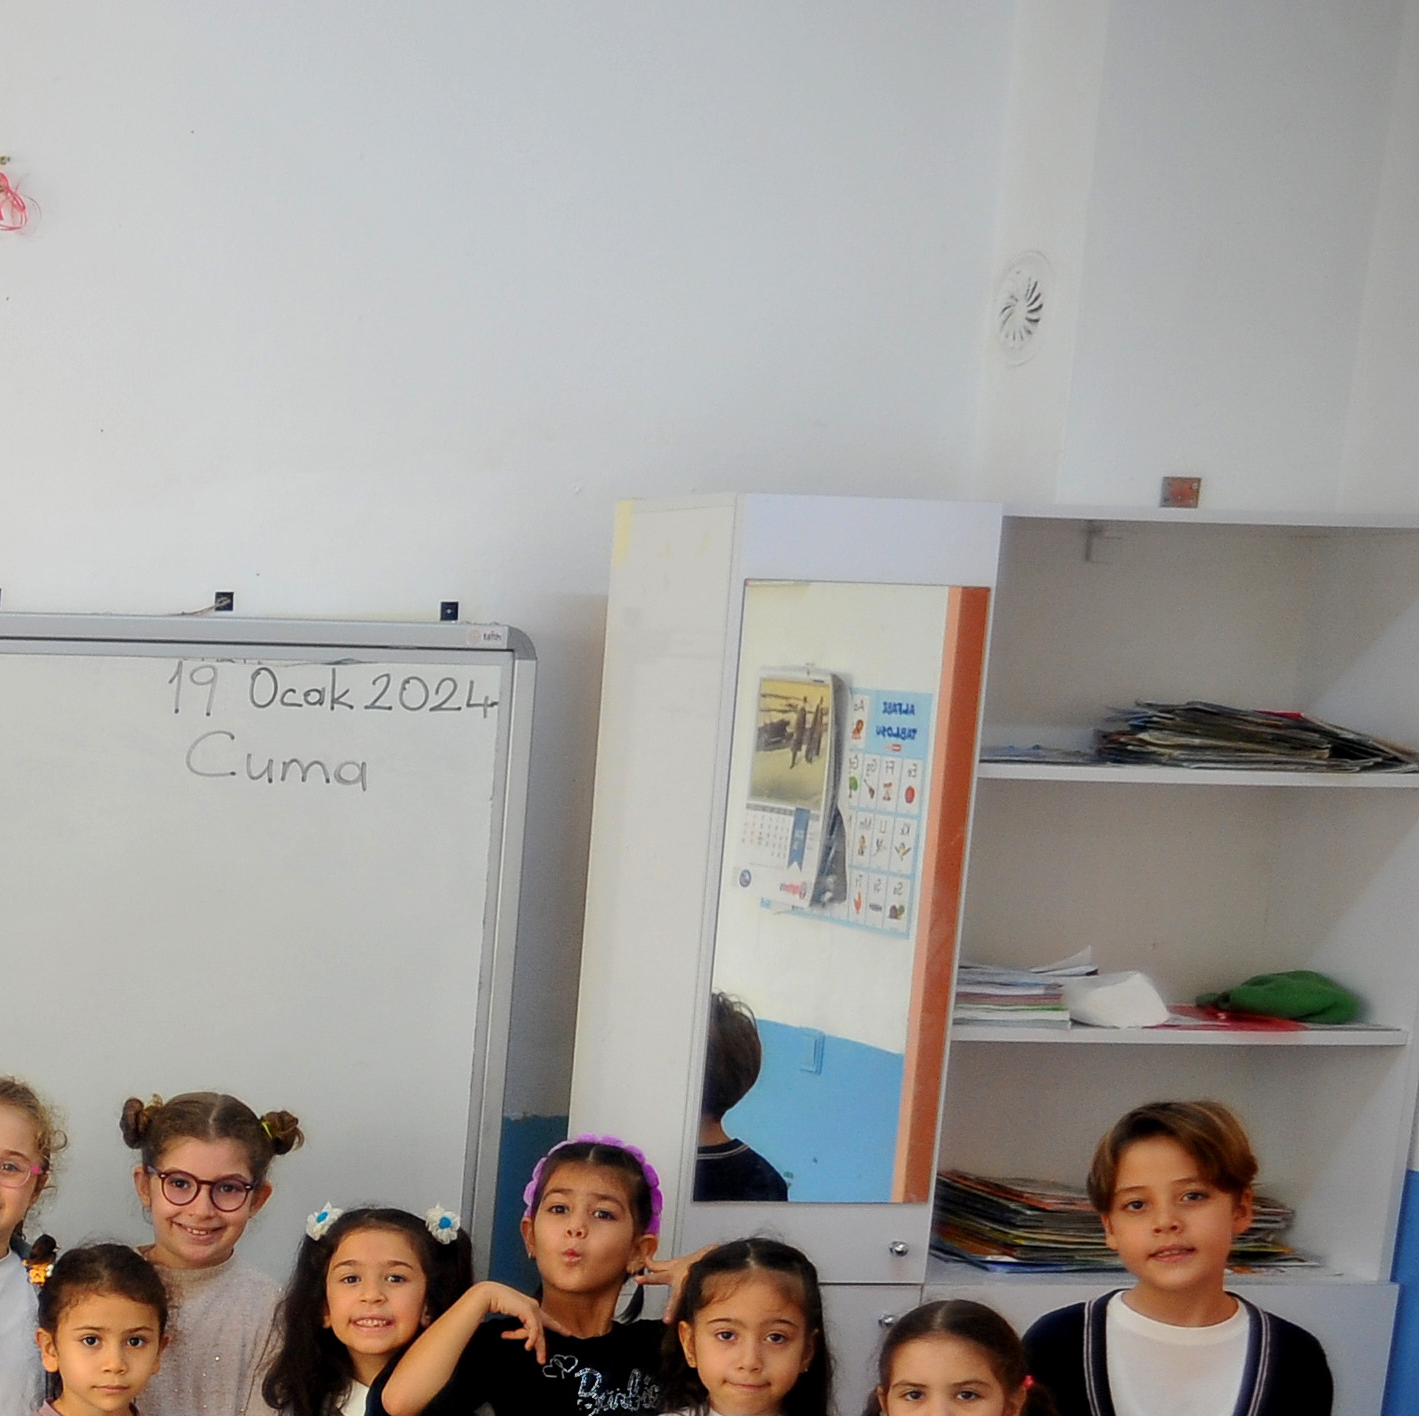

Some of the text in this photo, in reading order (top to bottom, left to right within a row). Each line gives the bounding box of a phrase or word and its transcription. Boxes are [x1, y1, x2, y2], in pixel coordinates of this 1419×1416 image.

[168, 660, 499, 718] 19 Ocak 2024
[185, 730, 368, 791] Cuma
